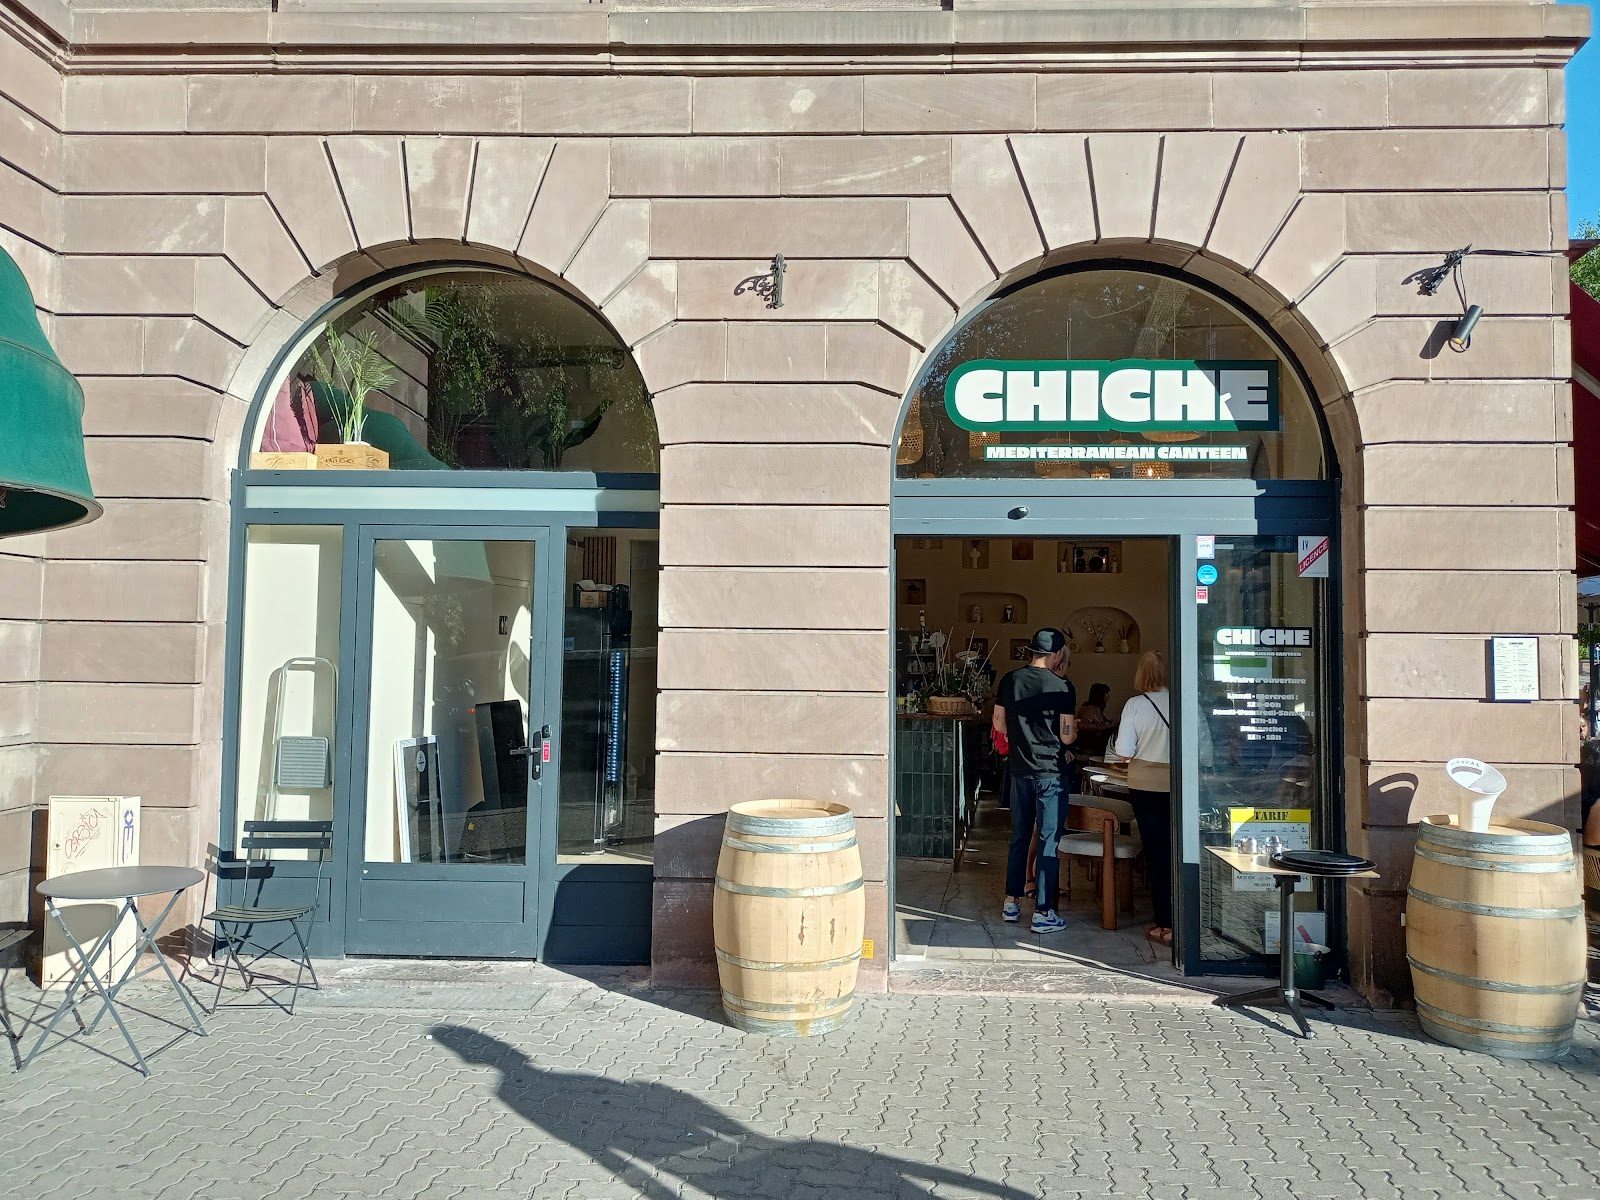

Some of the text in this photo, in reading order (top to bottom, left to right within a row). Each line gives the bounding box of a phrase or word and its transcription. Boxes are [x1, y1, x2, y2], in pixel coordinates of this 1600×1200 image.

[954, 369, 1269, 423] CHICHE
[986, 446, 1248, 460] MEDITERRANEAN CANTEEN
[1302, 540, 1309, 551] IV
[1299, 540, 1329, 573] LICENCE
[1216, 628, 1310, 646] CHICHE
[1254, 811, 1289, 821] TARIF
